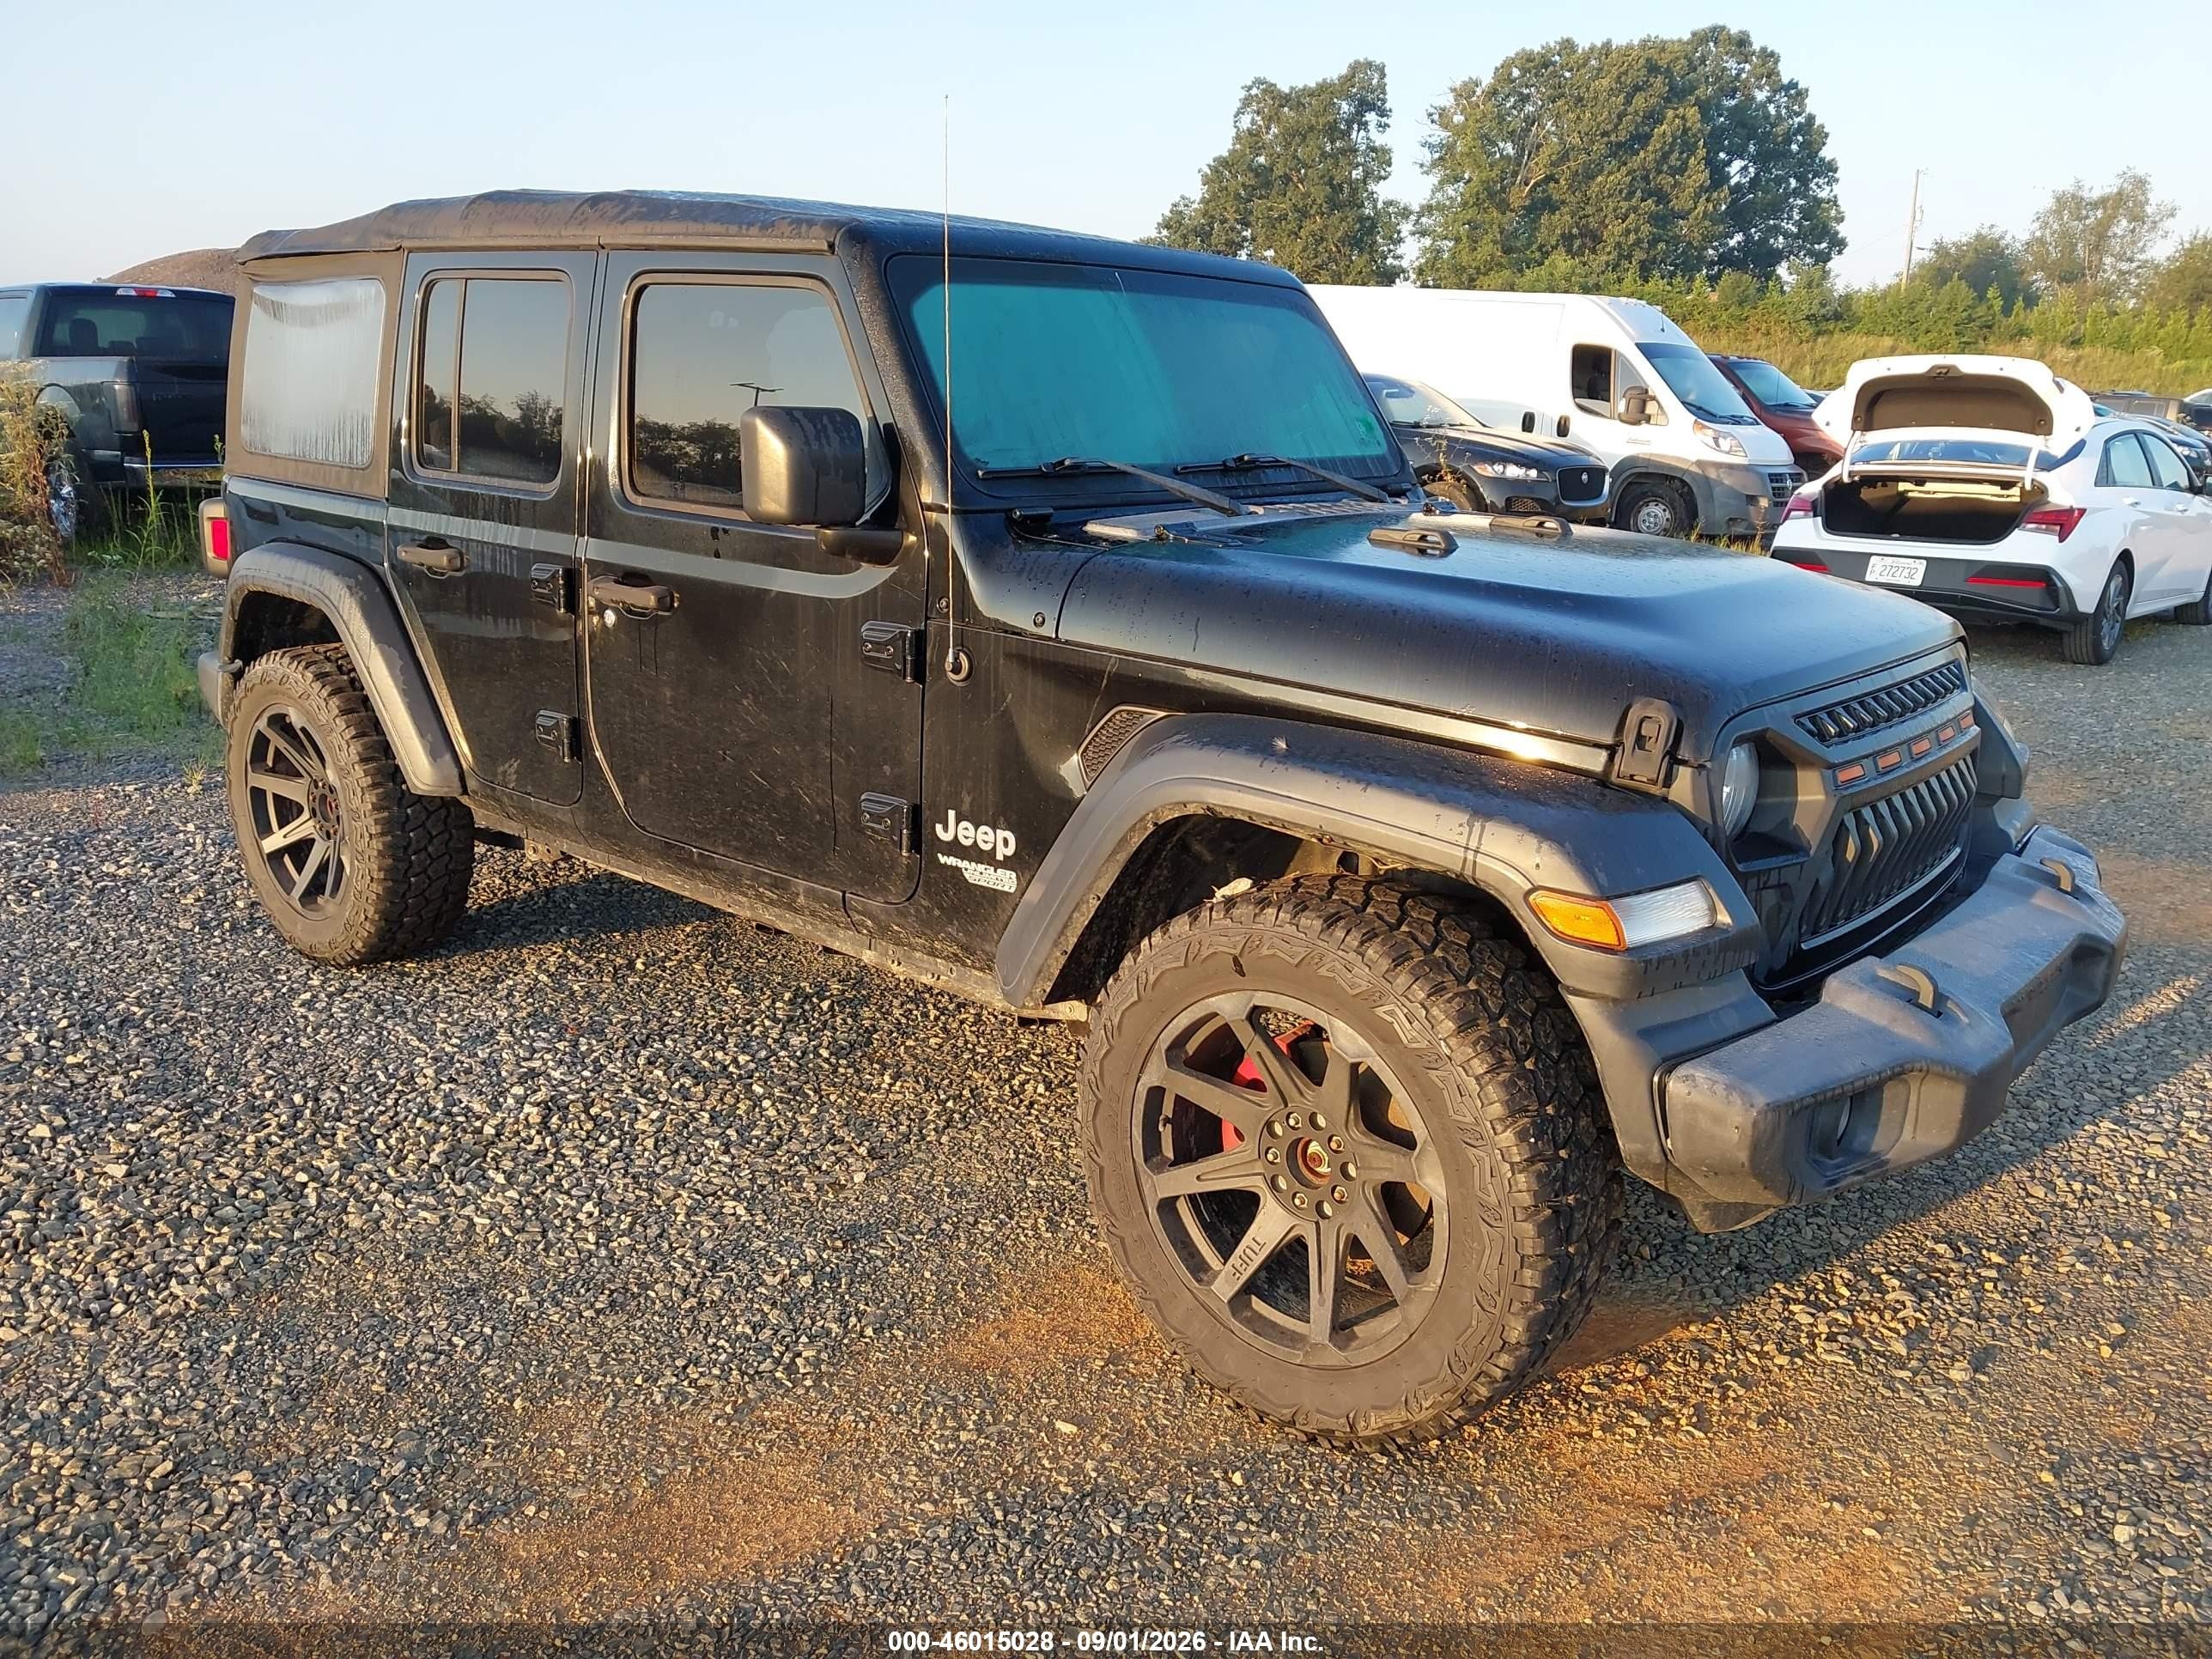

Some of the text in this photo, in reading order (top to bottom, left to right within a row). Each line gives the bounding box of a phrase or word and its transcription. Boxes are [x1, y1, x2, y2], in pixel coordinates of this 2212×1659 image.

[1879, 564, 1918, 580] 272732
[935, 809, 1017, 861] Jeep
[937, 853, 1017, 880] WRANGLER
[968, 876, 1016, 890] SPORT
[1231, 1237, 1267, 1281] TUFF
